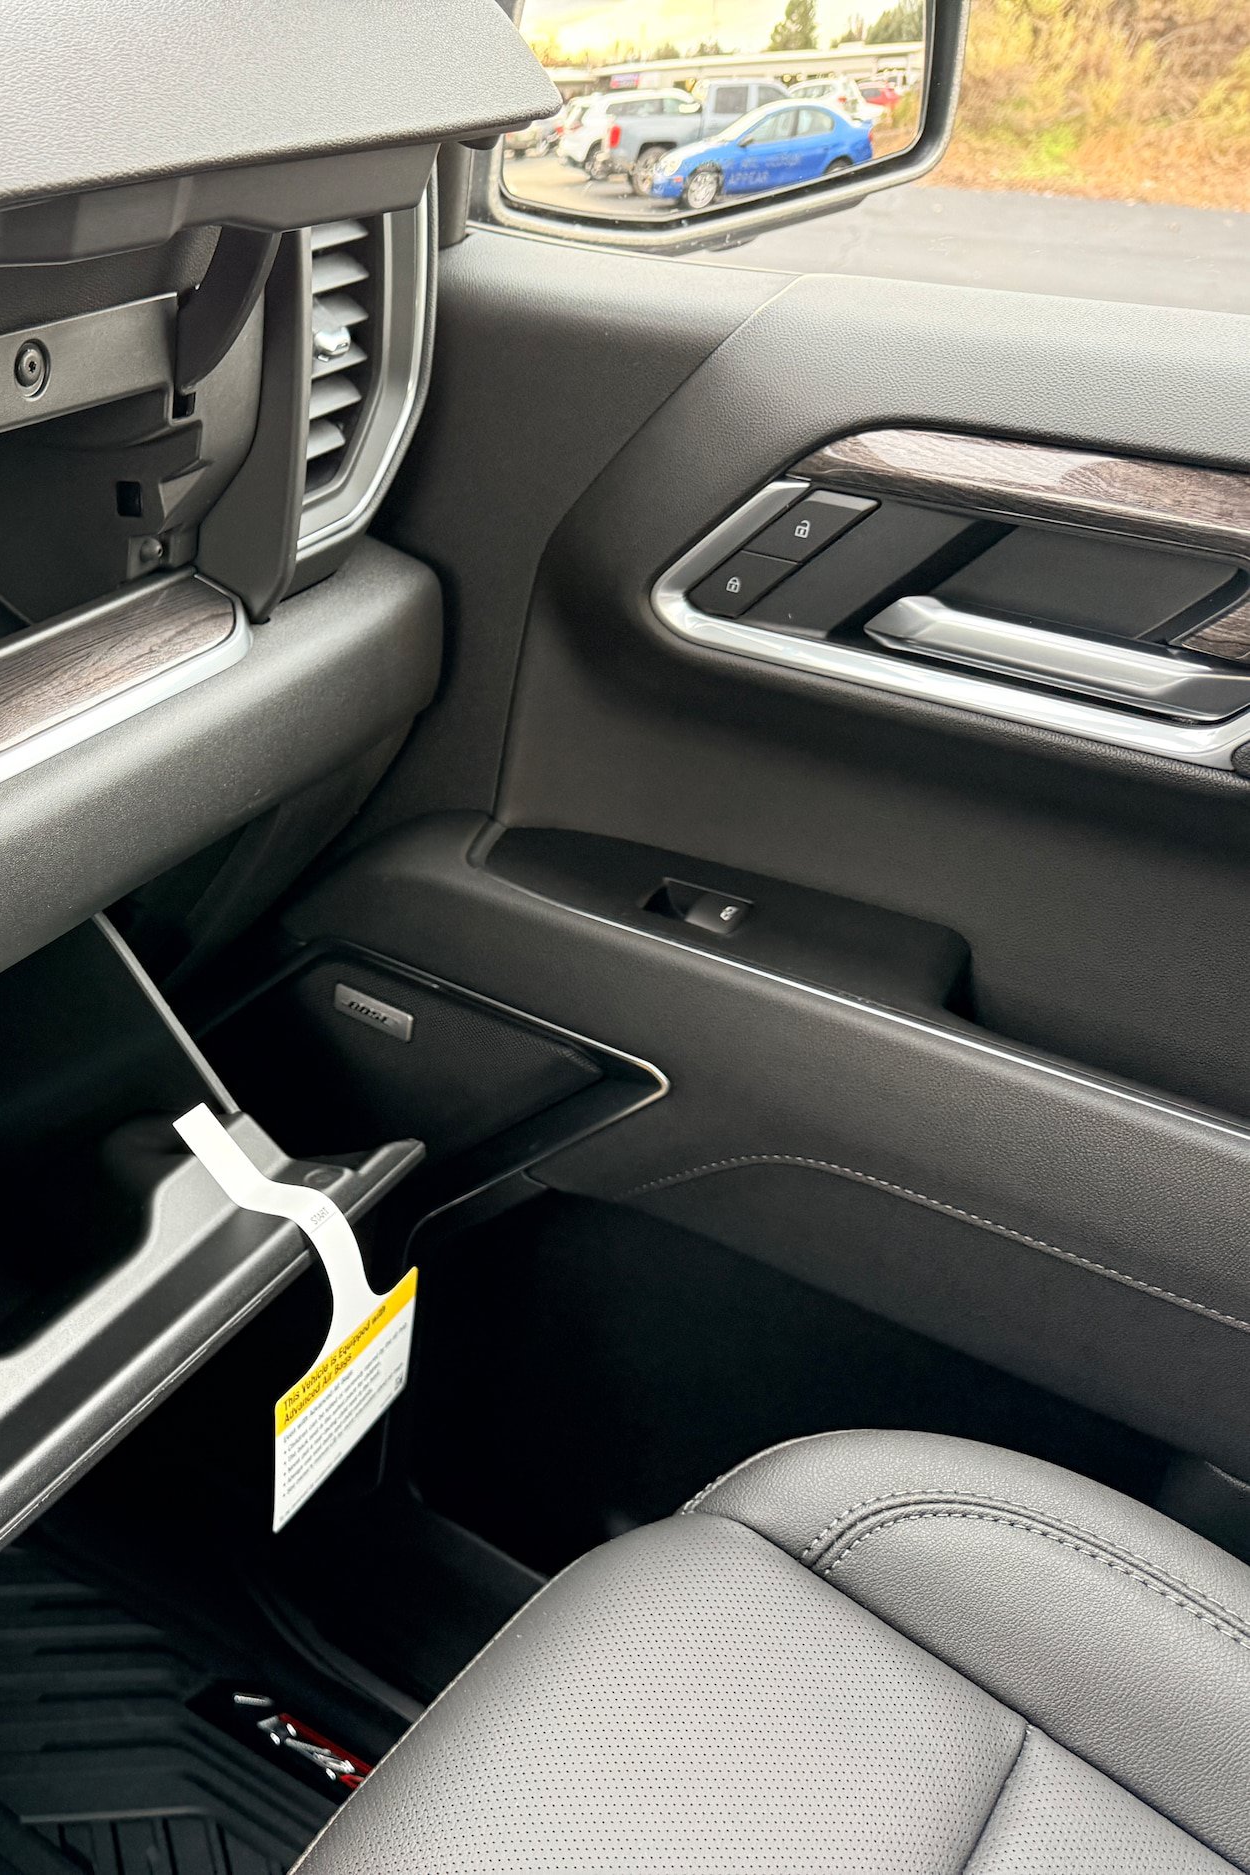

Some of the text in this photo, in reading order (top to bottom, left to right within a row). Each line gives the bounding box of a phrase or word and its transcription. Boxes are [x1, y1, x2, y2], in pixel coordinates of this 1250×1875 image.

[284, 1305, 386, 1411] This Vehicle is Equipped with
[284, 1353, 352, 1425] Advanced Air Bags
